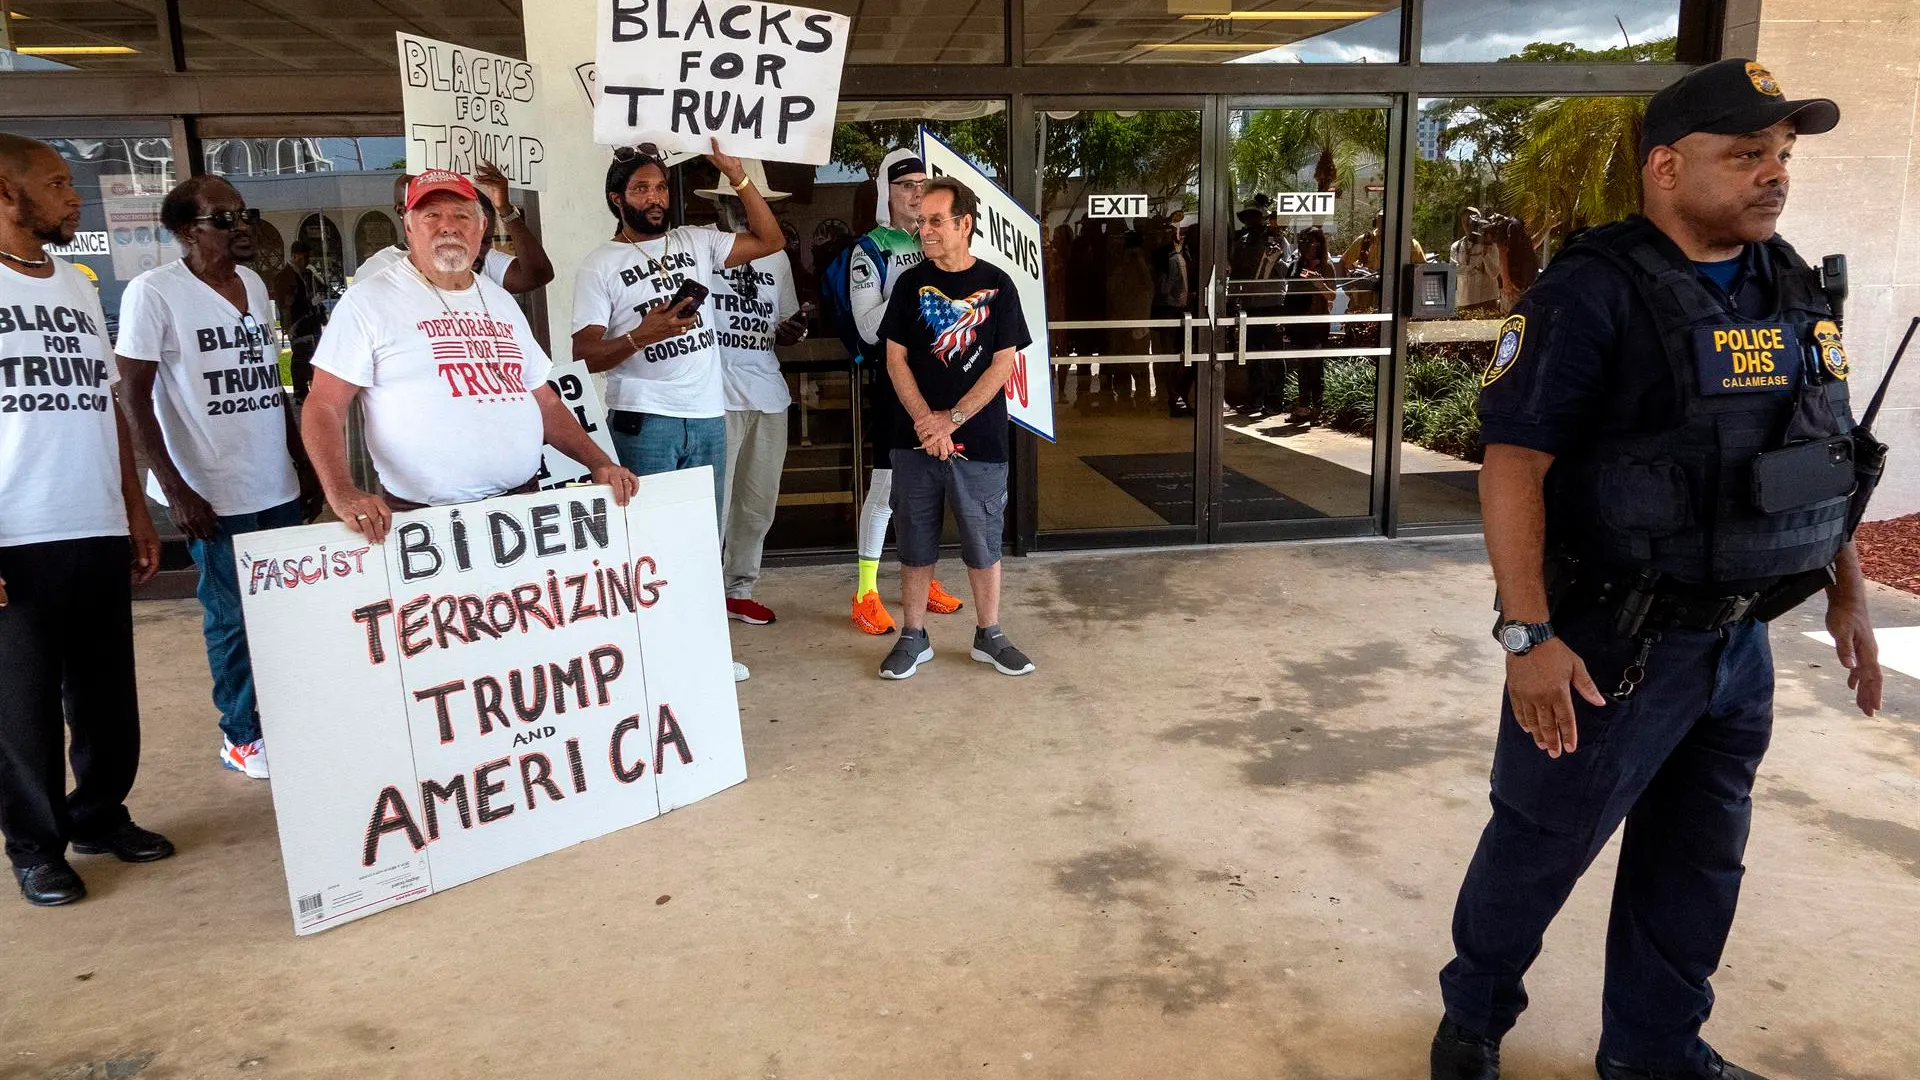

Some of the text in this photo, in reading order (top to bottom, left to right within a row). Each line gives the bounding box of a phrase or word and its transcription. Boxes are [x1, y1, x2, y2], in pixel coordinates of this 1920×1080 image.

[611, 0, 833, 53] BLACKS
[404, 40, 535, 102] BLACKS
[680, 50, 786, 89] FOR
[455, 97, 508, 126] FOR
[604, 86, 815, 144] TRUMP
[412, 124, 544, 184] TRUMP
[1090, 197, 1146, 216] EXIT
[1279, 195, 1333, 213] EXIT
[989, 206, 1039, 280] NEWS
[620, 252, 696, 287] BLACKS
[651, 272, 686, 293] FOR
[712, 293, 773, 318] TRUMP
[729, 316, 769, 334] 2020
[1501, 320, 1523, 337] POLICE
[43, 335, 81, 353] FOR
[465, 341, 495, 359] FOR
[1714, 328, 1785, 352] POLICE
[1732, 351, 1775, 373] DHS
[438, 363, 527, 397] TRUMP
[1722, 376, 1789, 388] CALAMEASE
[207, 392, 283, 415] 2020.CO
[412, 643, 624, 744] TRUMP
[512, 724, 556, 748] AND
[361, 703, 694, 867] AMERICA
